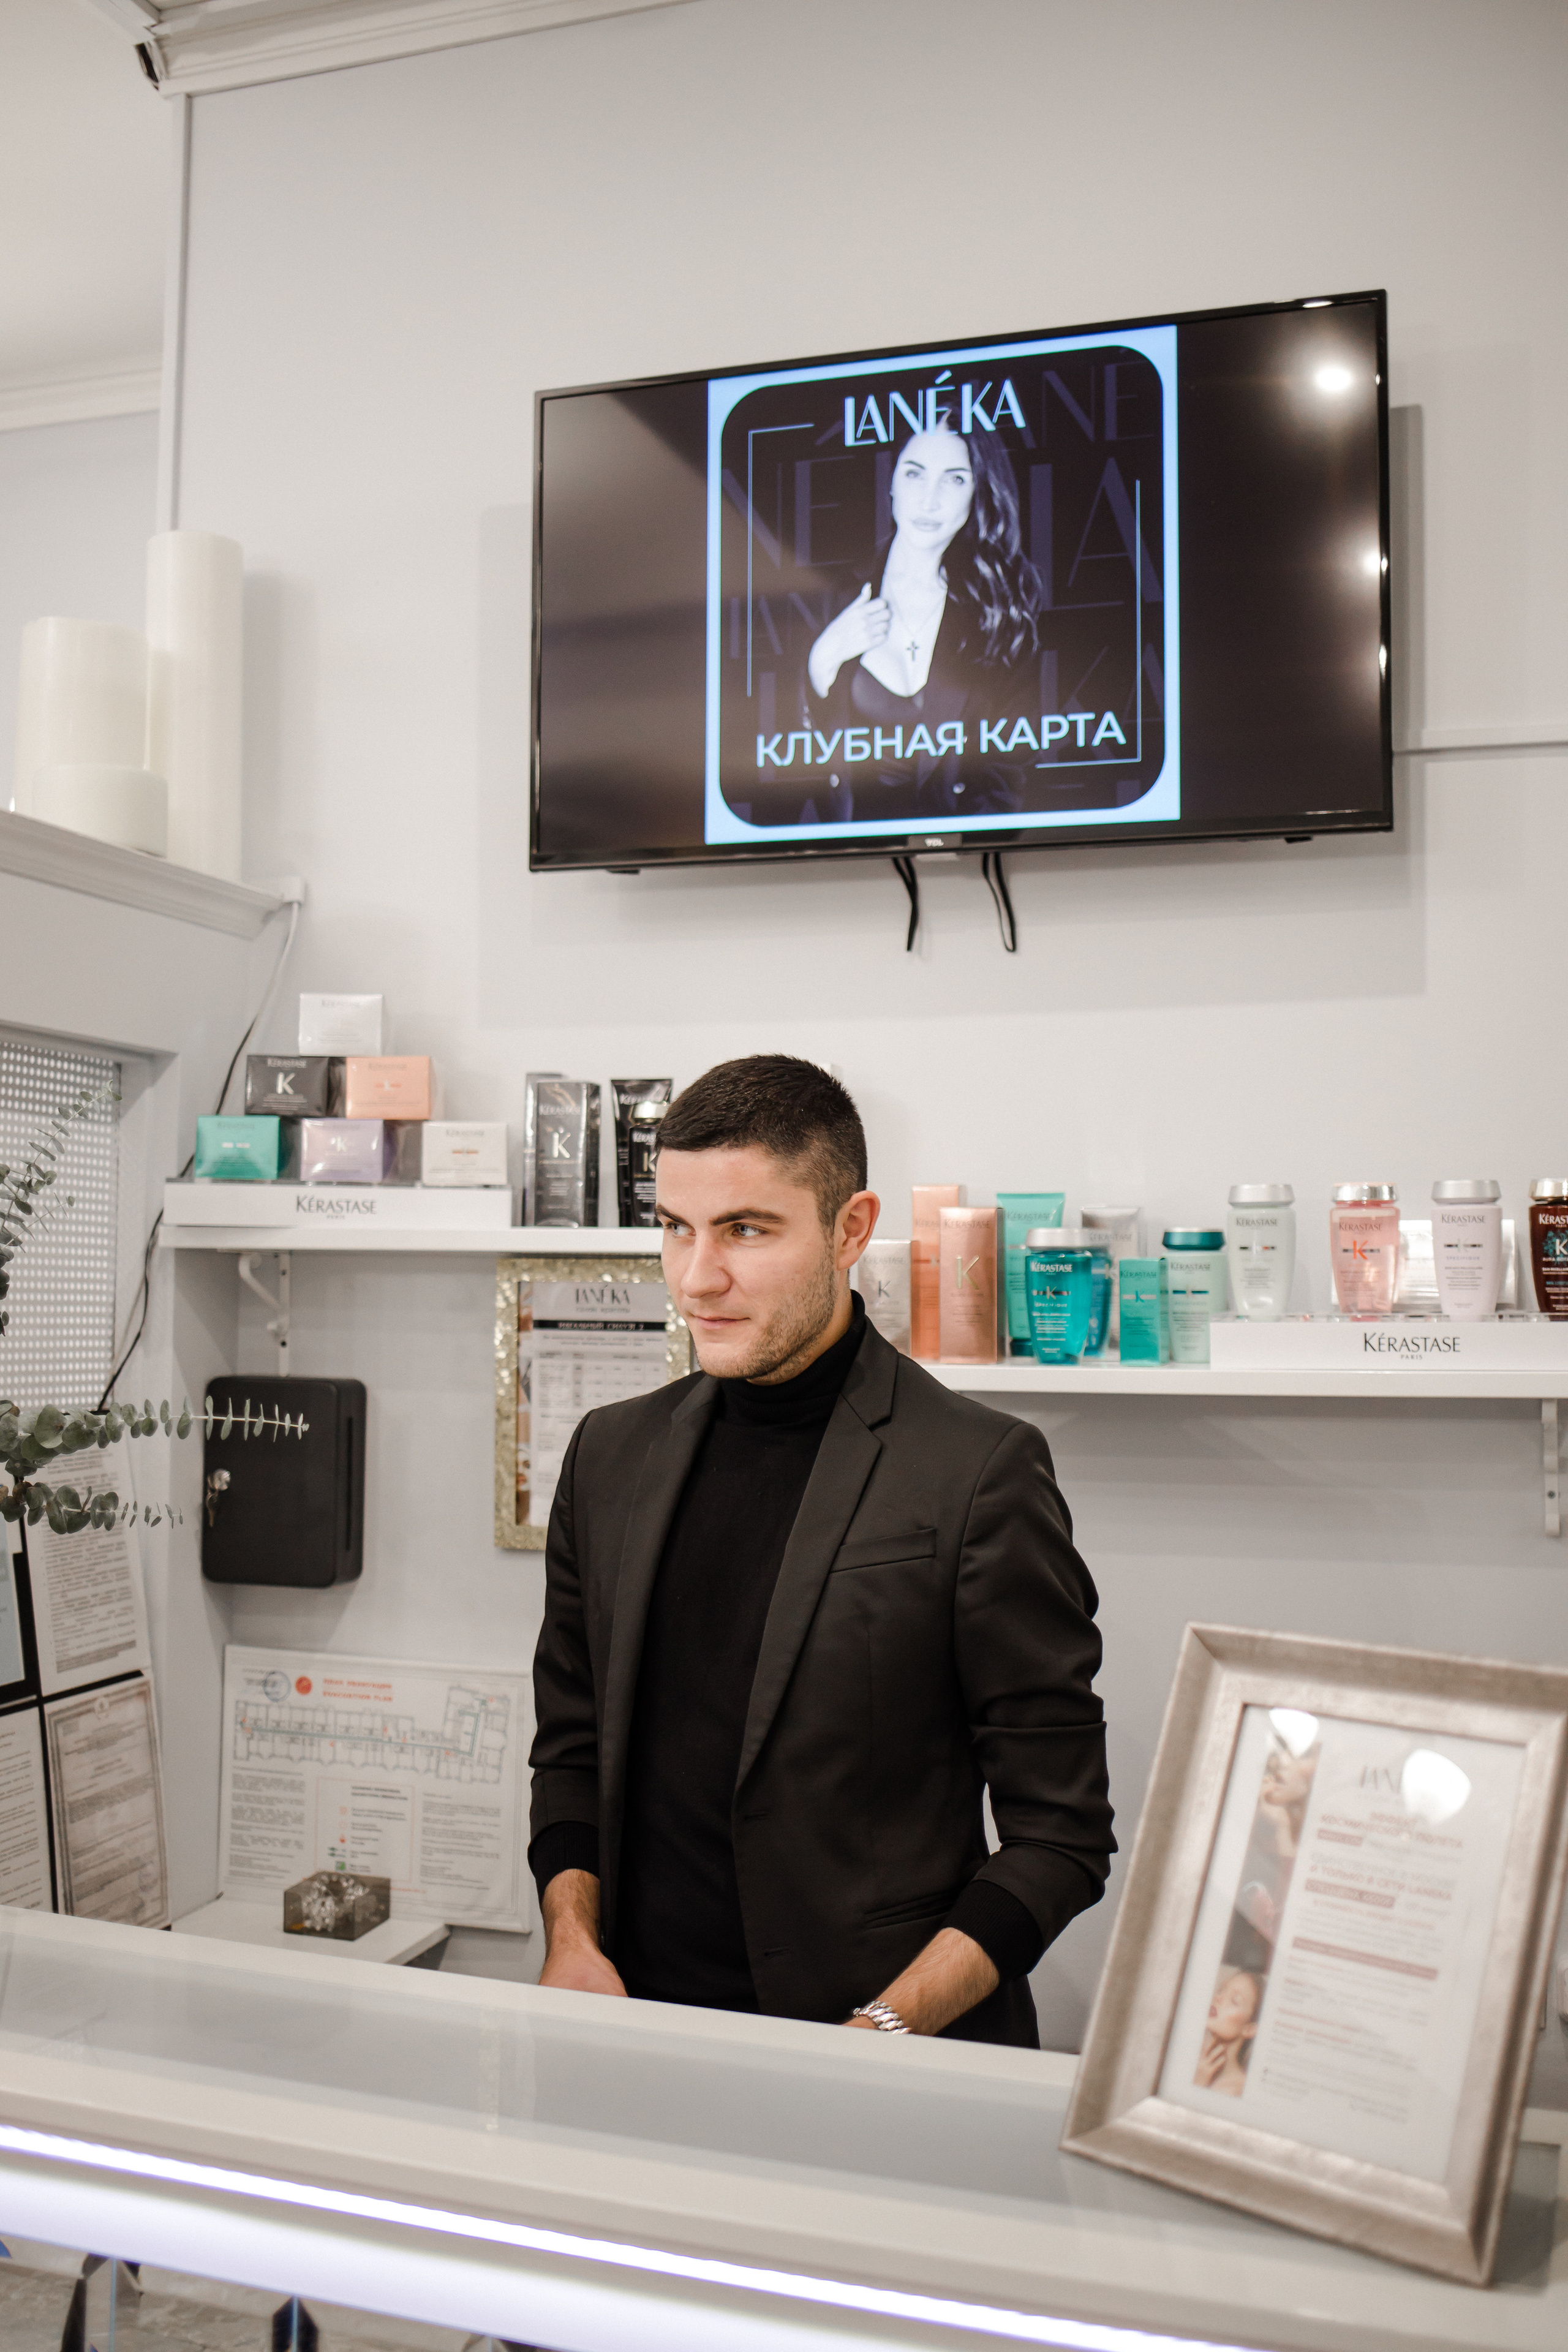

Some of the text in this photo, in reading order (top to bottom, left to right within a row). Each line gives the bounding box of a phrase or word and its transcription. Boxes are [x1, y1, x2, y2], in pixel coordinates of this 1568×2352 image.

[844, 371, 1027, 447] LANÉKA
[756, 711, 1126, 767] КЛУБНАЯ КАРТА
[552, 1133, 571, 1159] K
[296, 1194, 377, 1215] KÉRASTASE
[1441, 1213, 1486, 1224] KÉRASTASE
[1539, 1213, 1568, 1224] KÉRAST
[1352, 1240, 1369, 1260] K
[955, 1254, 980, 1290] K
[1030, 1261, 1073, 1273] KÉRASTASE
[878, 1280, 891, 1298] K
[1363, 1332, 1461, 1352] KÉRASTASE
